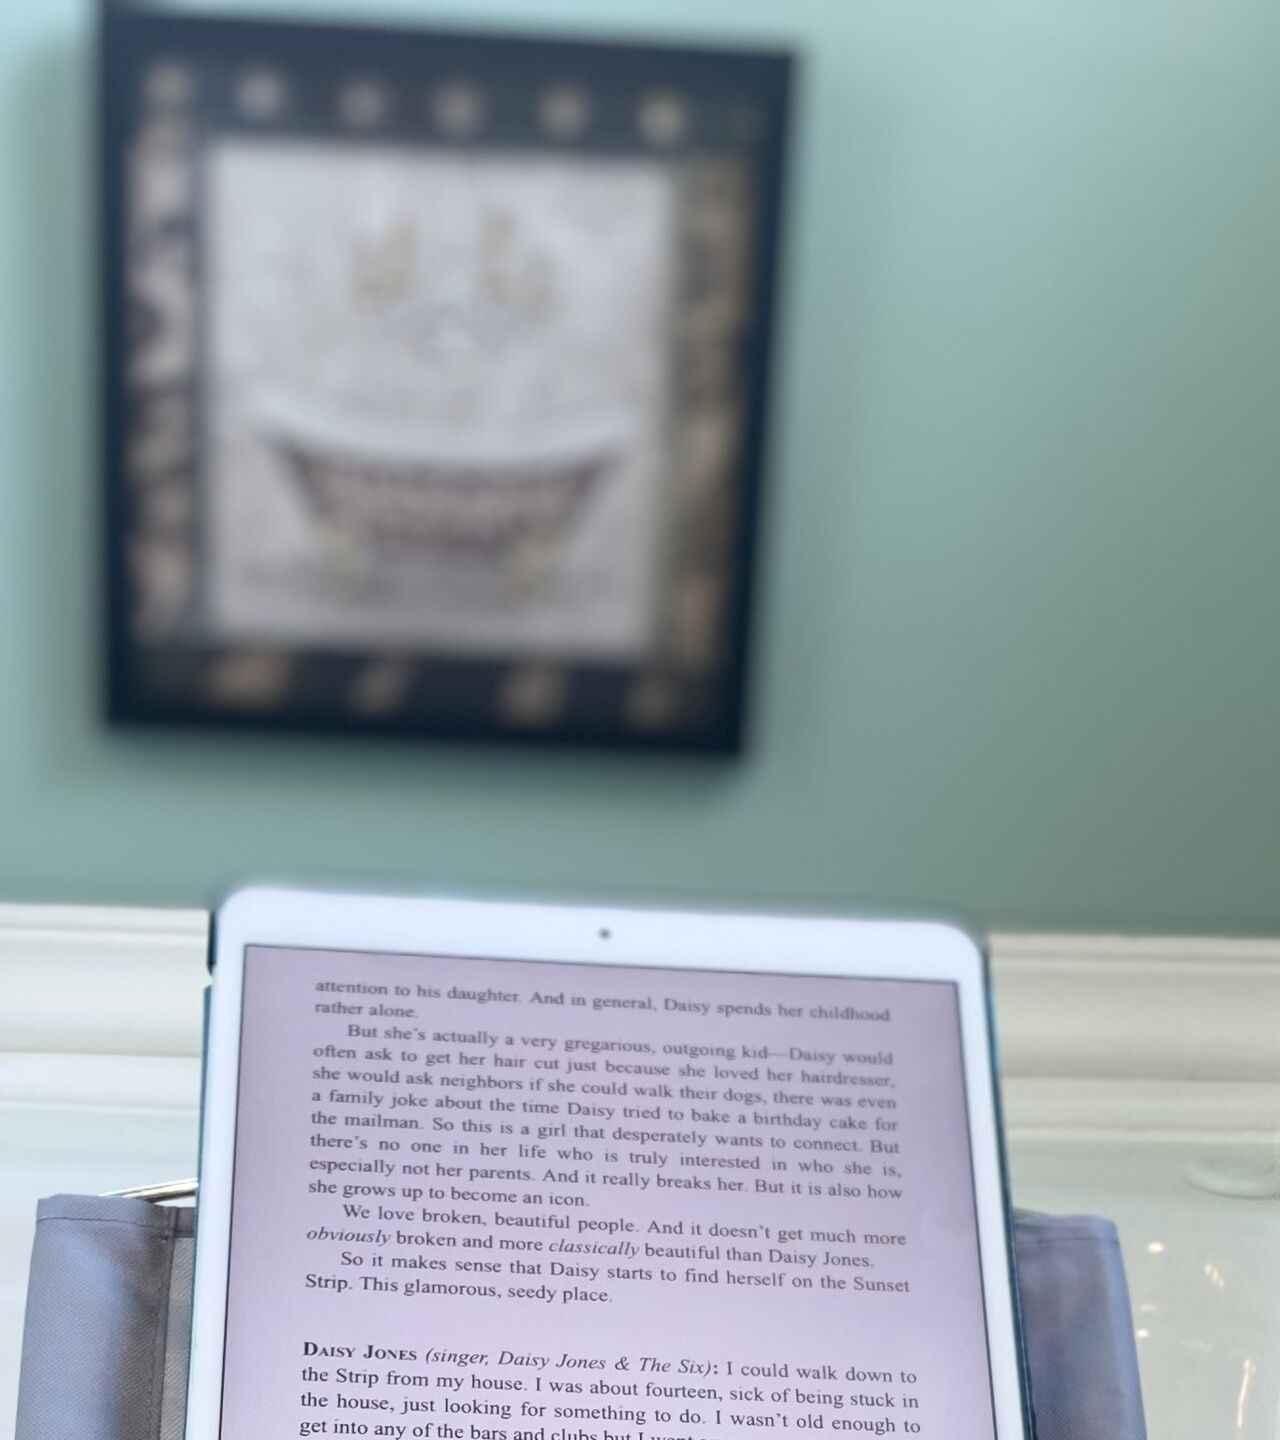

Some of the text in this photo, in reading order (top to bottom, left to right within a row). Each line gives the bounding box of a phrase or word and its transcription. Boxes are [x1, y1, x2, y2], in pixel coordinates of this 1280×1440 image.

[314, 981, 891, 1023] attention to his daughter. And in general, Daisy spends her childhood
[314, 1000, 419, 1019] rather alone.
[311, 1088, 898, 1132] a family joke about the time Daisy tried to bake a birthday cake for
[310, 1110, 900, 1154] the mailman. So this is a girl that desperately wants to connect. But
[308, 1178, 589, 1207] she grows up to become an icon.
[306, 1225, 873, 1269] obviously broken and more classically beautiful than Daisy Jones.
[305, 1273, 613, 1305] Strip. This glamorous, seedy place.
[425, 1347, 489, 1368] (singer,
[497, 1350, 551, 1371] Daisy
[555, 1353, 607, 1370] Jones
[614, 1355, 630, 1372] &
[639, 1356, 672, 1373] The
[677, 1358, 719, 1378] Six):
[727, 1361, 733, 1376] I
[740, 1362, 790, 1379] could
[796, 1365, 838, 1381] walk
[845, 1366, 893, 1383] down
[899, 1370, 917, 1384] to
[298, 1420, 328, 1438] get
[332, 1418, 369, 1436] into
[373, 1424, 407, 1440] any
[411, 1422, 435, 1438] of
[436, 1422, 465, 1440] the
